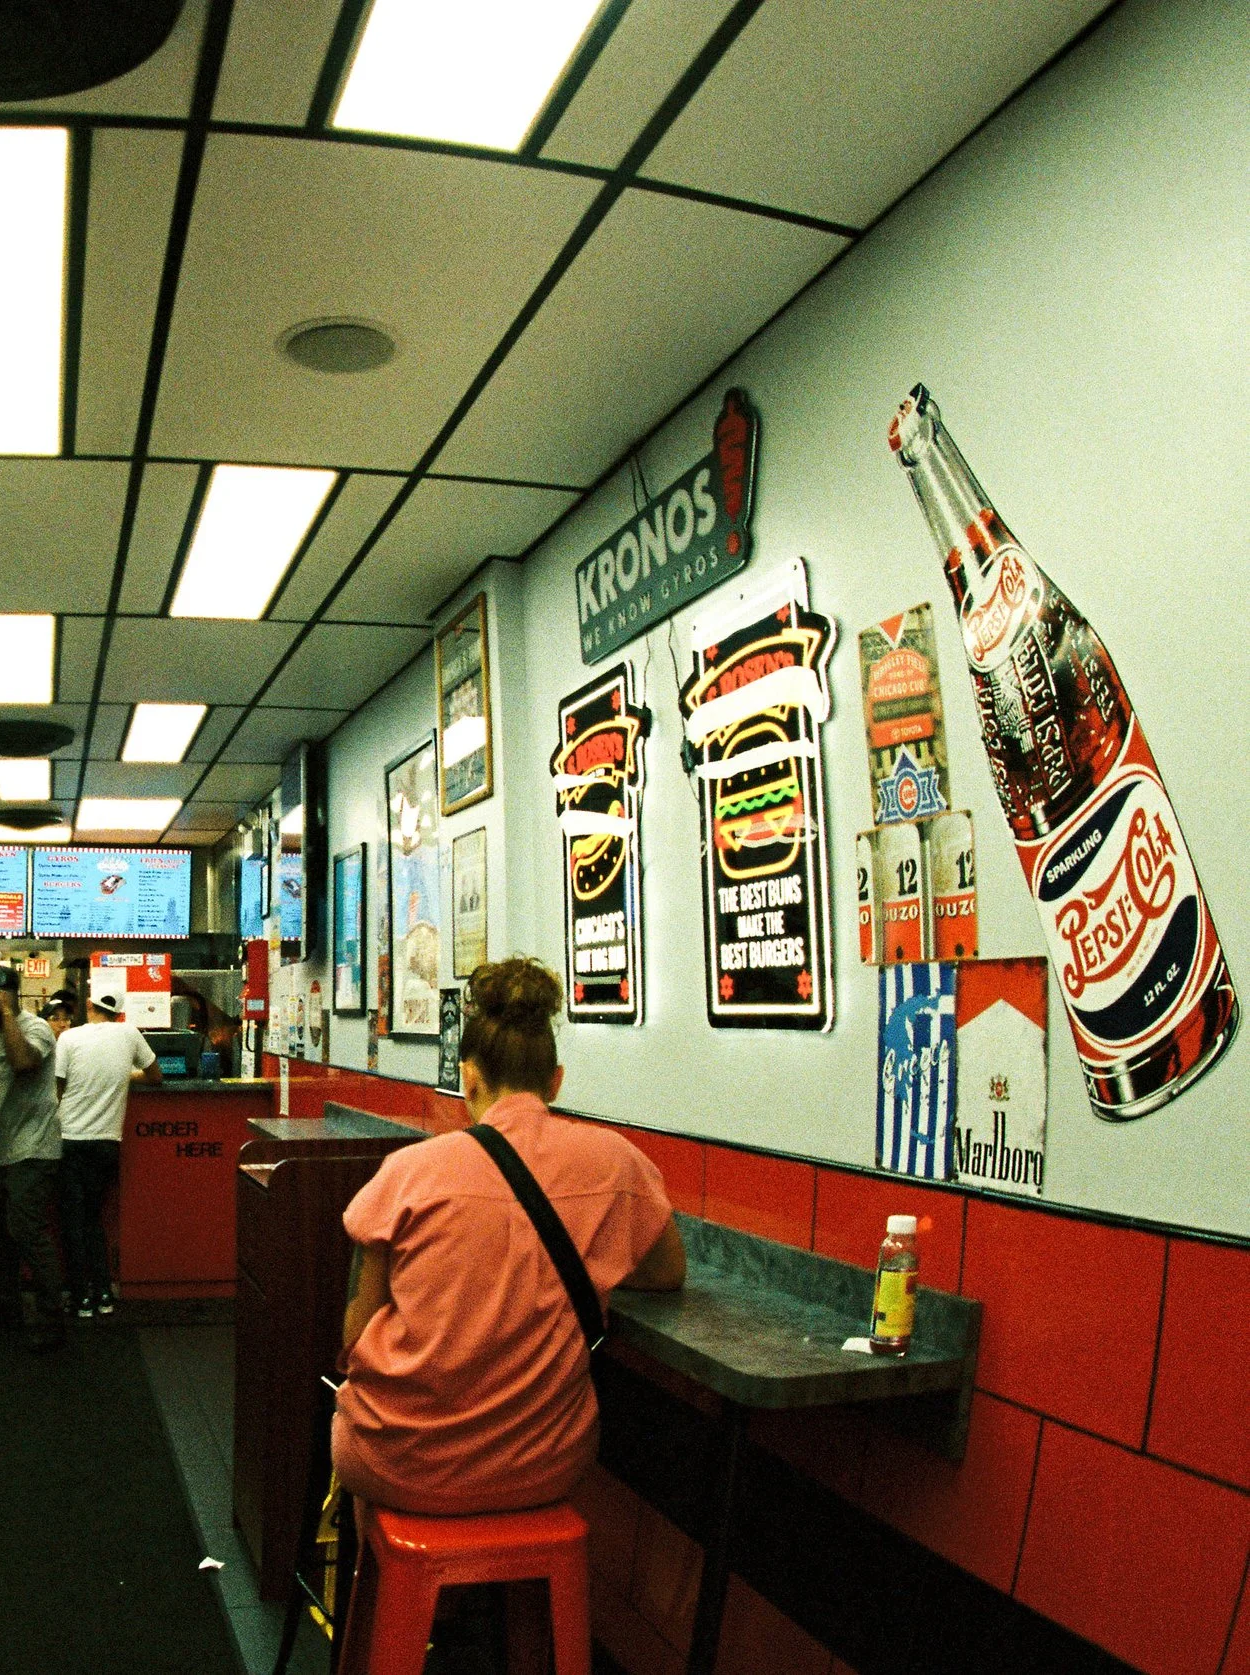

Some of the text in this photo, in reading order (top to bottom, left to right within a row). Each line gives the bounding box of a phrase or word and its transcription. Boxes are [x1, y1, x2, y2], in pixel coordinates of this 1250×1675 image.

[578, 468, 717, 624] KRONOS
[608, 593, 652, 635] KNOW
[660, 546, 718, 600] GYROS
[873, 682, 908, 698] CHICAGO
[900, 725, 923, 737] TOYOTA
[47, 855, 80, 863] GYROS
[1046, 828, 1103, 883] SPARKLING
[43, 881, 83, 889] BURGERS
[896, 858, 918, 896] 12
[718, 874, 803, 914] THE BEST BUNS
[737, 910, 785, 939] MAKE THE
[28, 959, 47, 973] EXIT
[720, 936, 805, 970] BEST BURGERS
[1143, 990, 1154, 1008] 12
[882, 1039, 950, 1094] Greece
[135, 1121, 198, 1136] ORDER
[176, 1142, 223, 1157] HERE
[954, 1110, 1044, 1187] Marlboro
